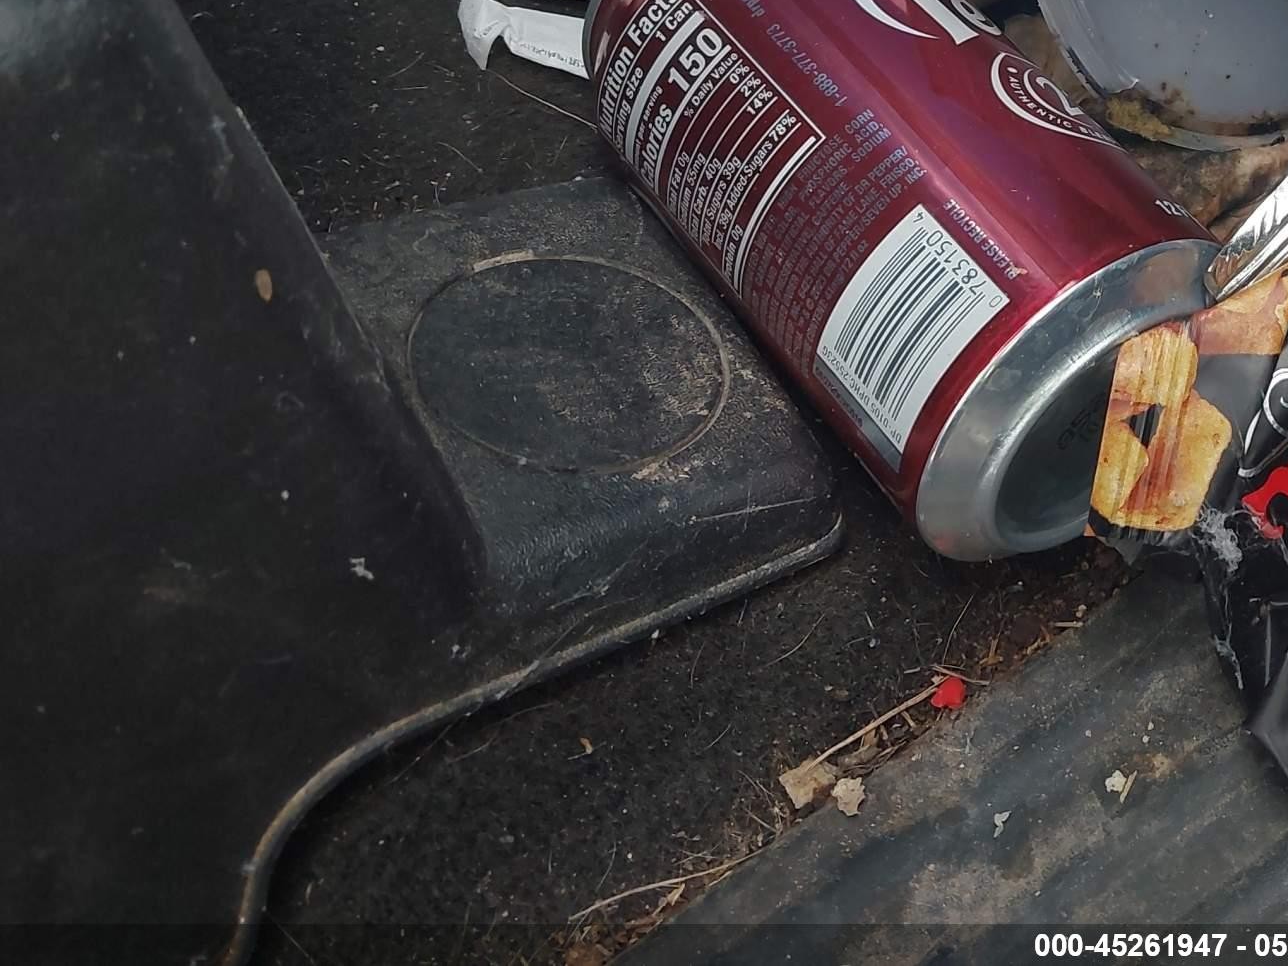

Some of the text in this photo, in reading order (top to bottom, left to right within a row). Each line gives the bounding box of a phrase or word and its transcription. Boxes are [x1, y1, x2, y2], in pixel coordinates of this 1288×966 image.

[624, 66, 645, 99] size
[656, 30, 667, 42] 1
[665, 1, 693, 31] Can
[684, 52, 739, 118] % Daily Value
[767, 22, 849, 107] 1-888-377-3773
[599, 46, 635, 138] Nutrition
[639, 28, 723, 187] Calories 150
[642, 85, 664, 121] serving
[669, 168, 682, 187] Fat
[676, 151, 691, 167] 0g
[729, 64, 750, 85] 0%
[1008, 76, 1073, 129] AUTHENTIC
[678, 77, 762, 226] Sodium 55mg 2%
[691, 181, 709, 213] Carb.
[704, 157, 722, 180] 40g
[746, 90, 773, 116] 14%
[714, 114, 797, 249] Incl. 39g Added Sugars 78%
[797, 134, 844, 182] FRUCTOSE
[843, 109, 874, 134] CORN
[798, 143, 853, 202] PHOSPHORIC
[855, 119, 882, 143] ACID,
[842, 192, 857, 206] OF
[854, 179, 870, 194] DR
[867, 145, 907, 181] PEPPER/
[851, 126, 891, 162] SODIUM
[879, 157, 919, 188] FRISCO,
[905, 166, 927, 185] INC.
[705, 181, 728, 219] Sugars
[721, 155, 742, 180] 39g
[723, 223, 744, 280] Protein 0g
[912, 211, 1002, 309] 0 783150 4
[943, 198, 1019, 280] PLEASE RECYCLE
